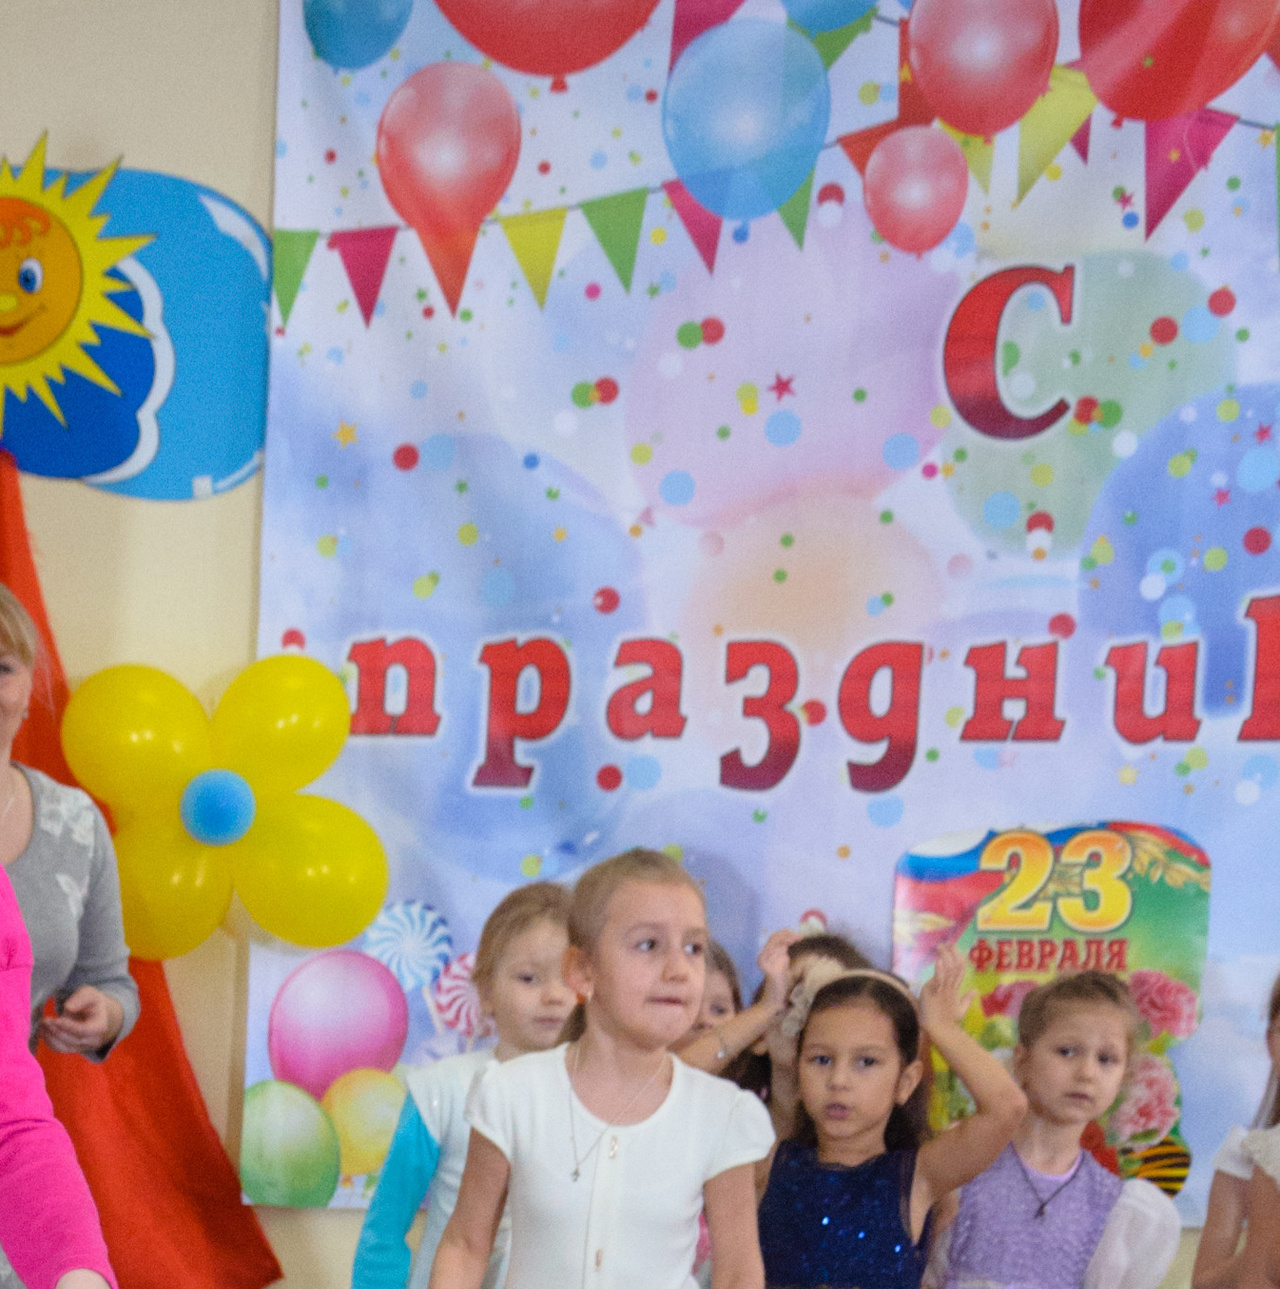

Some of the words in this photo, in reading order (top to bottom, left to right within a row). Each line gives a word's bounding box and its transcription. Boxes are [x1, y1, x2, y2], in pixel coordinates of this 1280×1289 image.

[943, 264, 1075, 441] С
[976, 829, 1133, 933] 23
[969, 938, 1128, 973] ФЕВРАЛЯ
